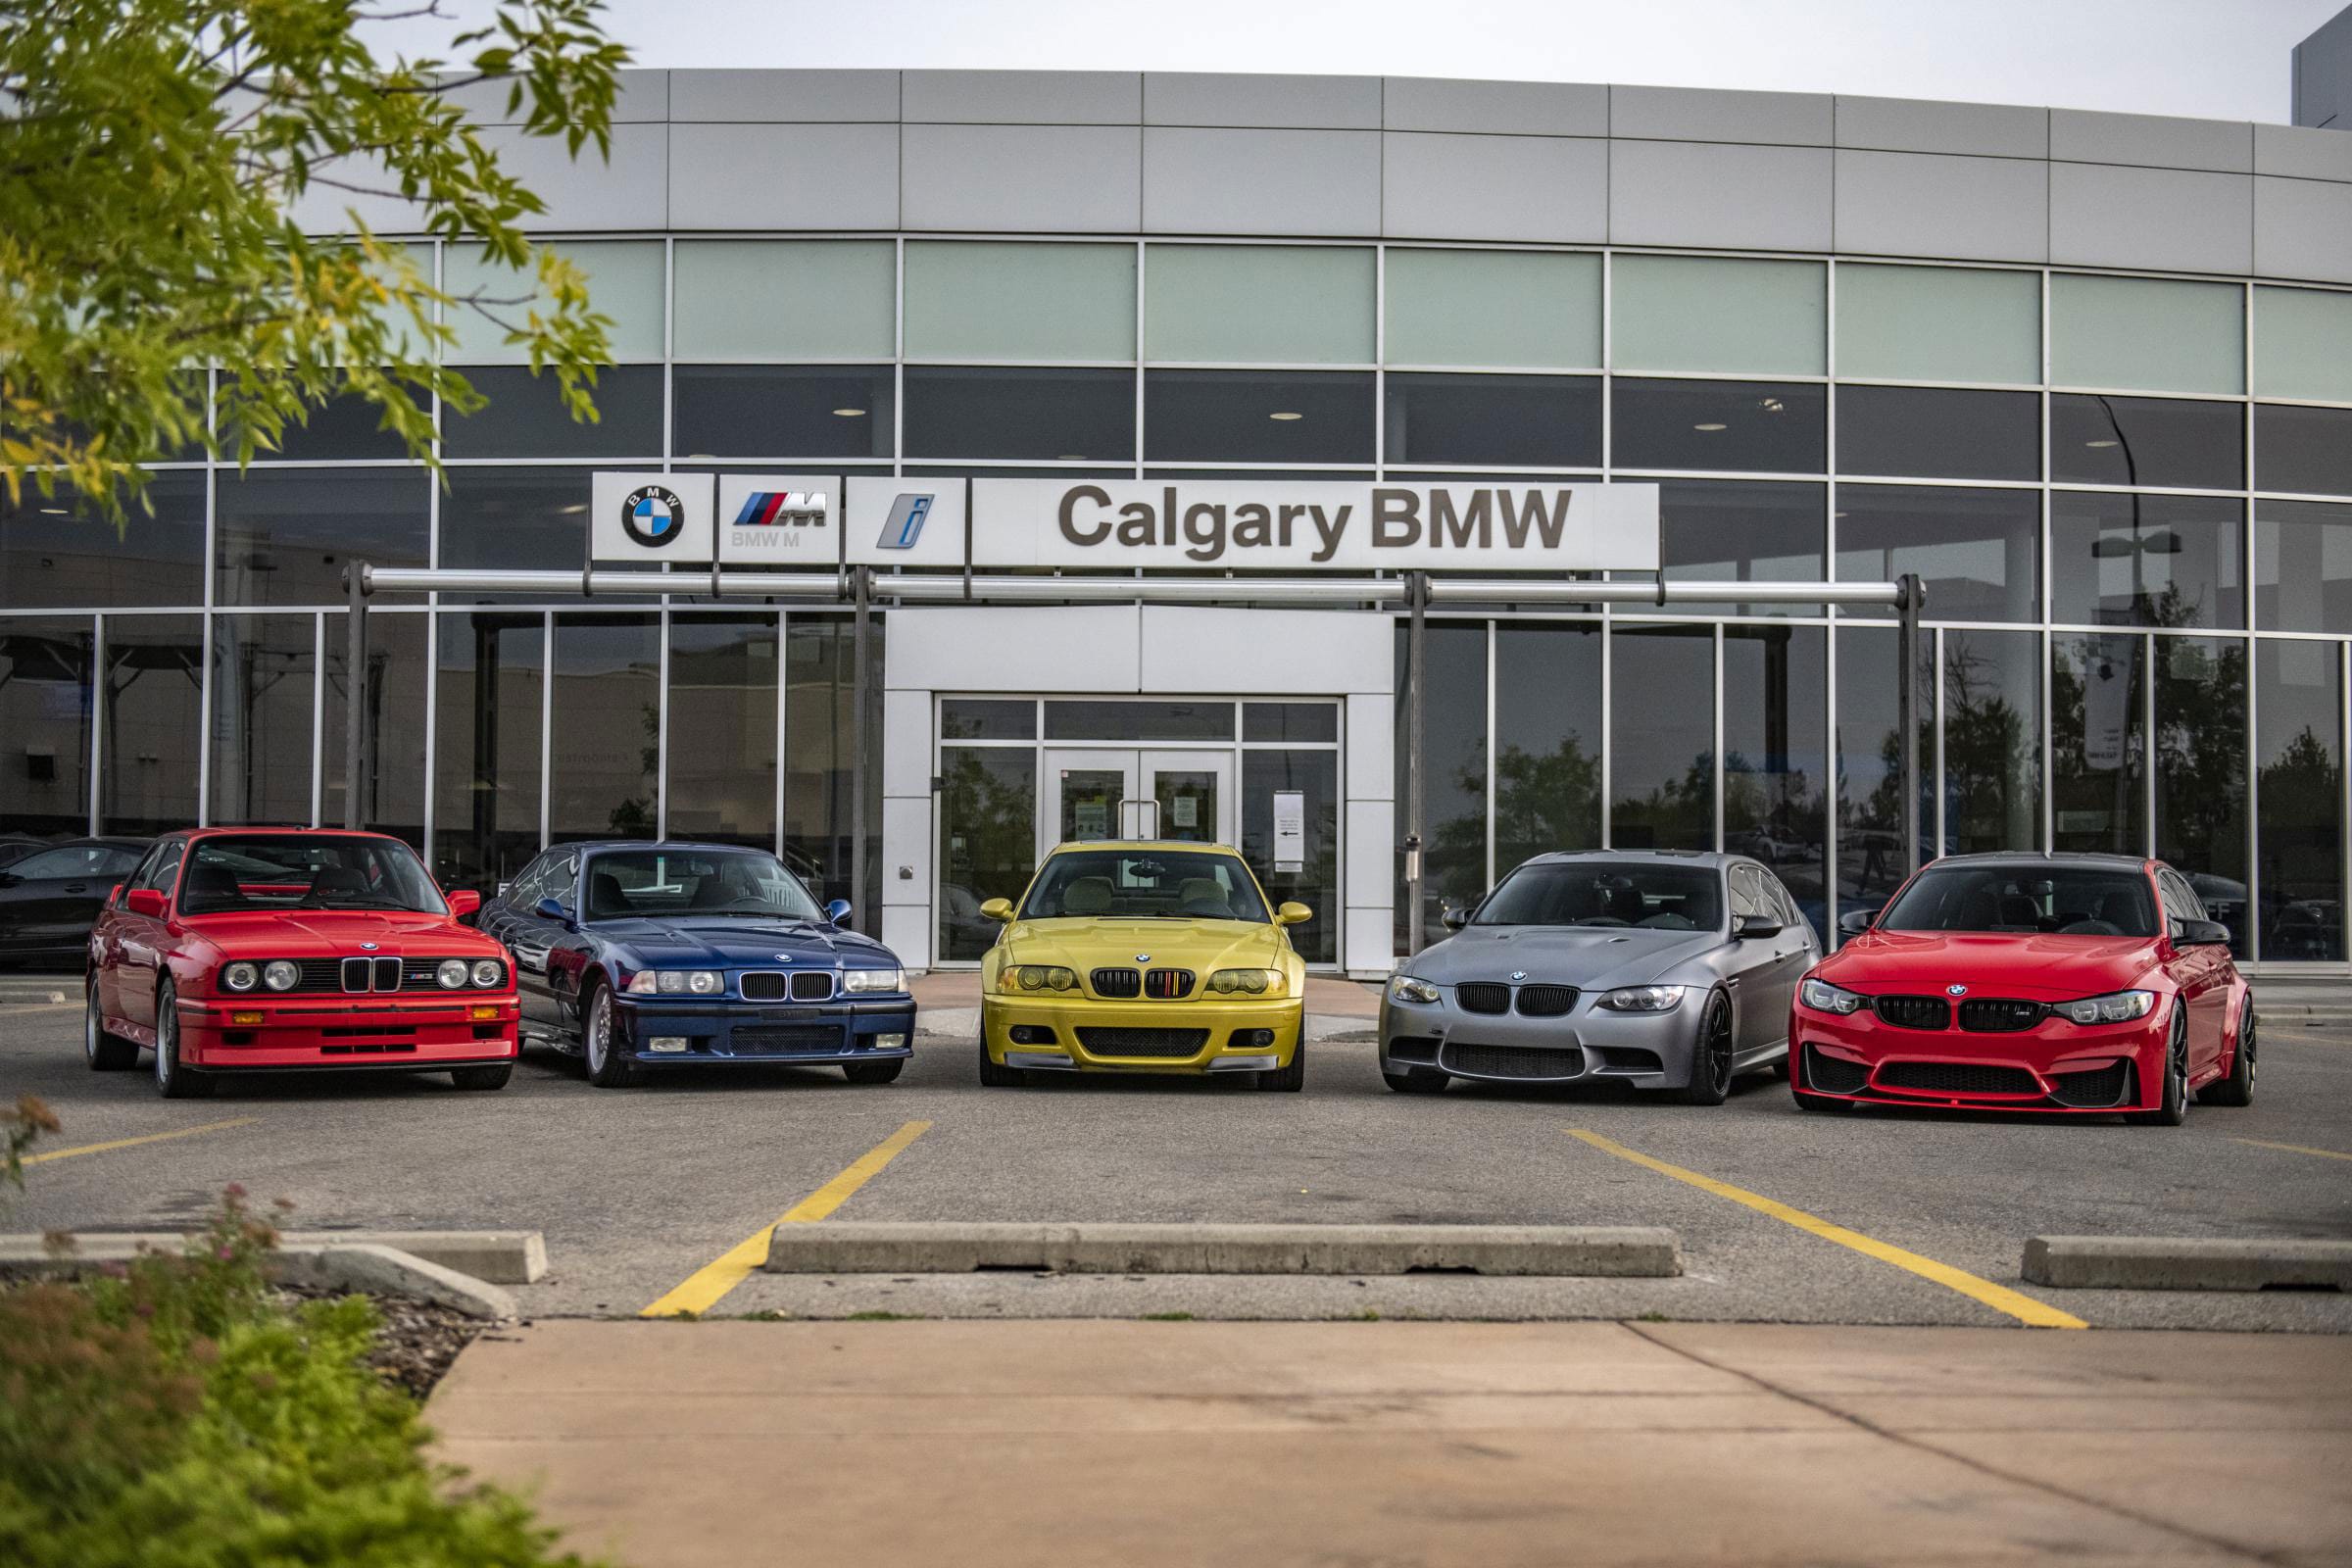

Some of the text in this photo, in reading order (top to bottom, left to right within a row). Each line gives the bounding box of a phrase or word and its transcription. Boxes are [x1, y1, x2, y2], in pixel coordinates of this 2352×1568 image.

[627, 487, 679, 507] BMW
[770, 492, 826, 526] M
[1058, 485, 1573, 563] Calgary BMW
[731, 532, 800, 547] BMW M
